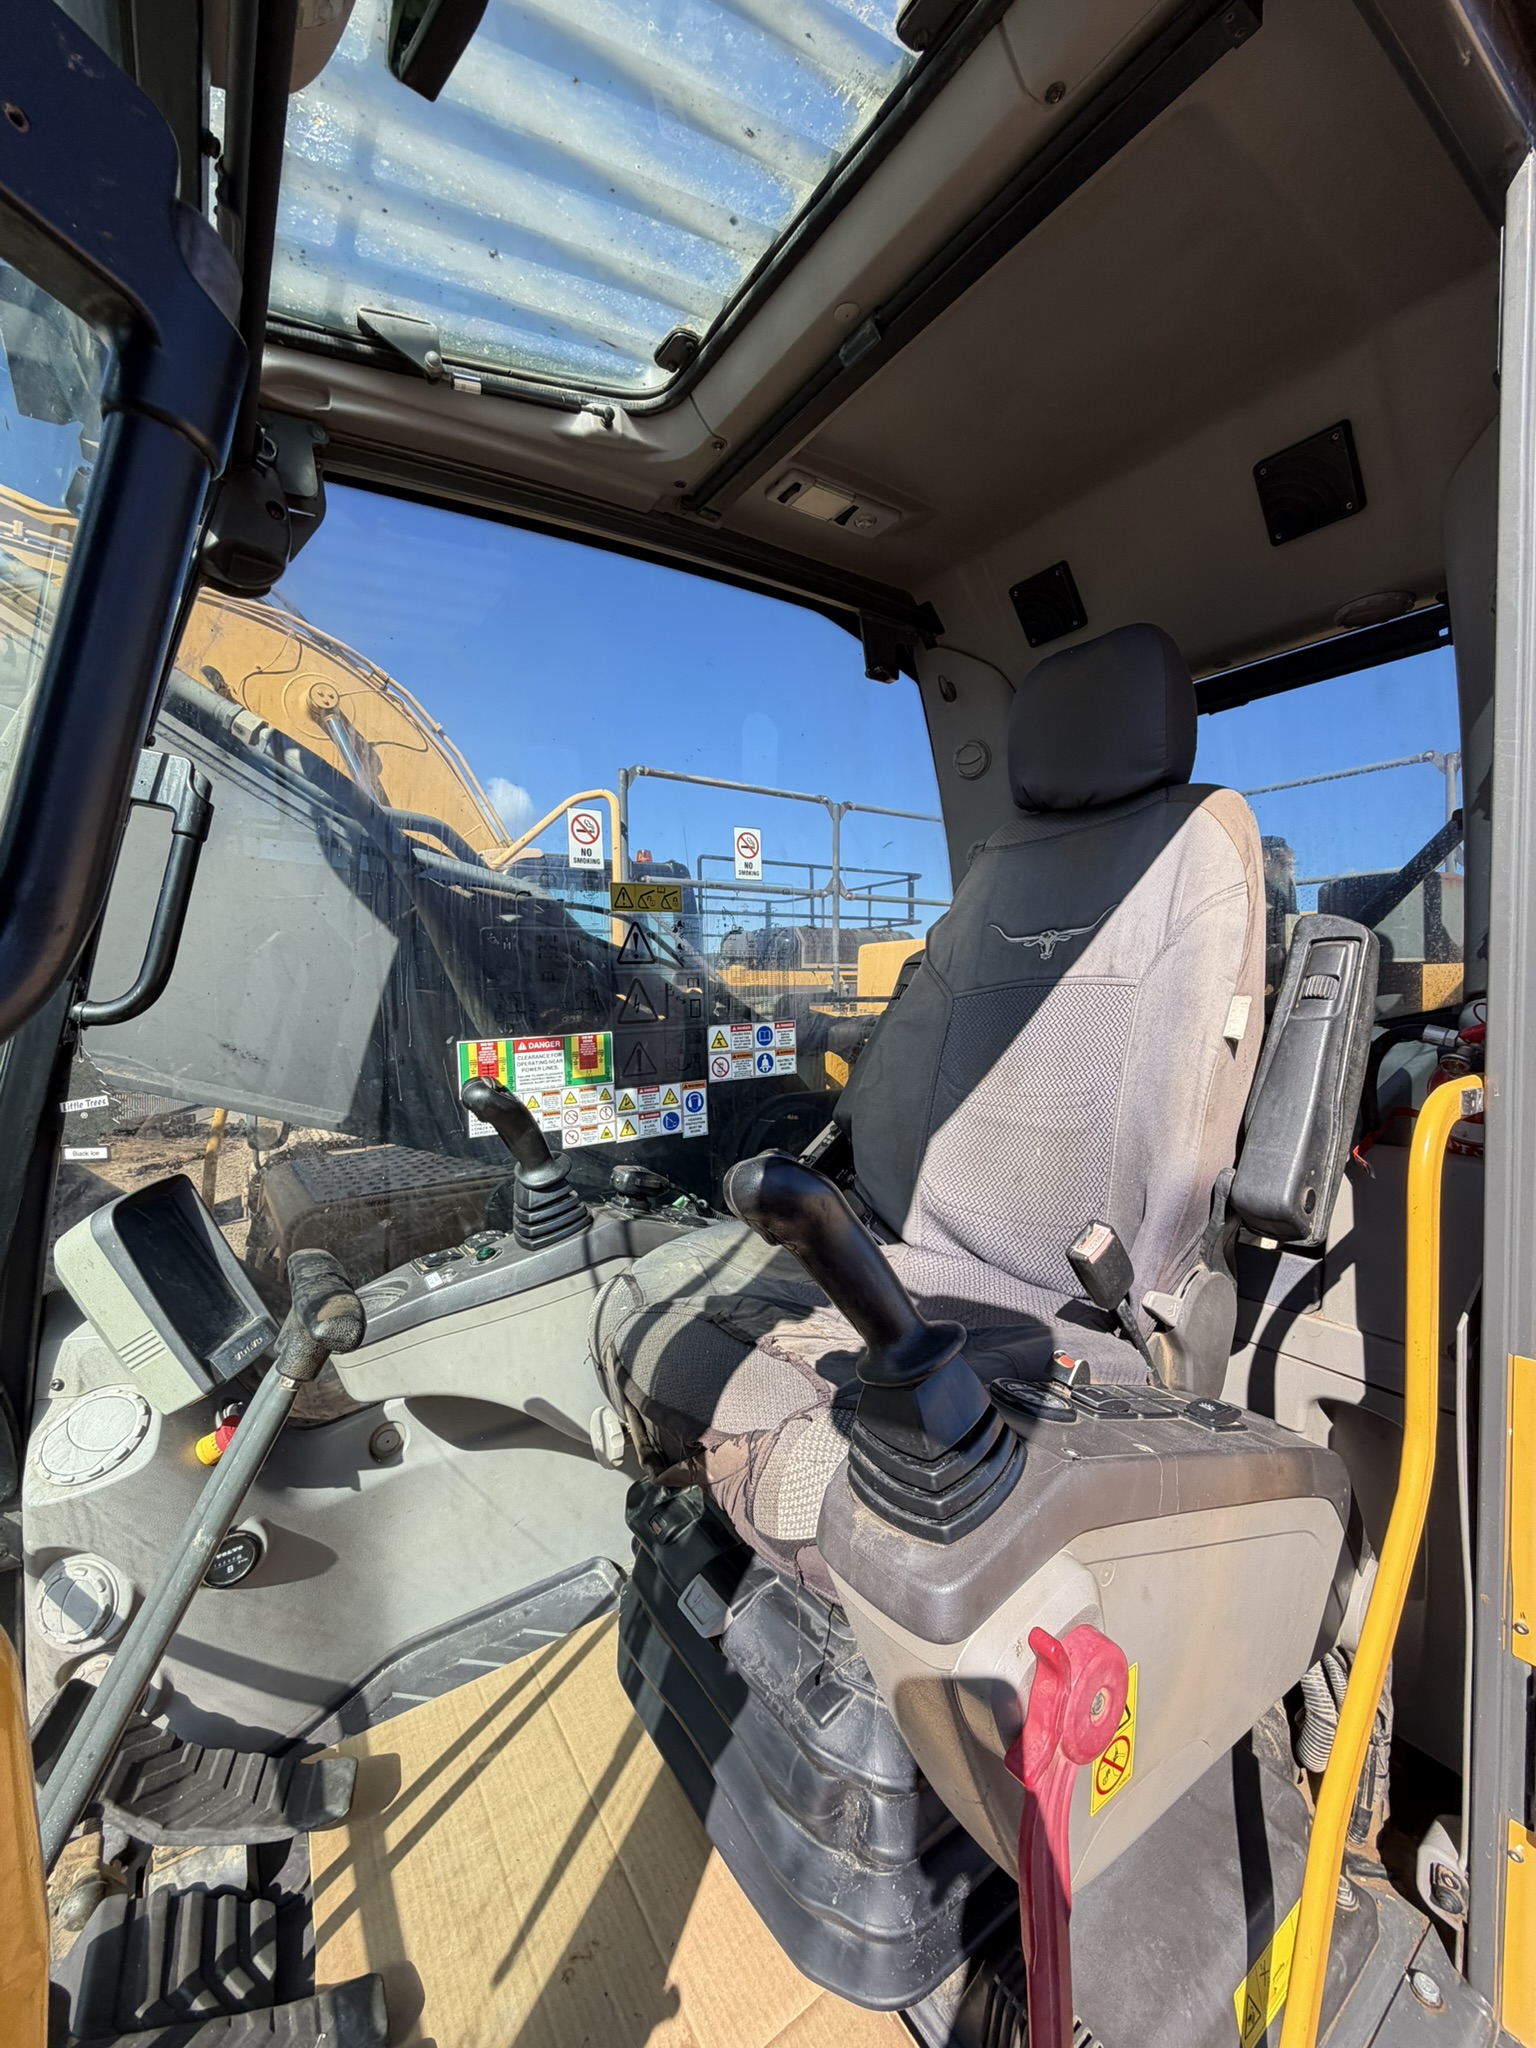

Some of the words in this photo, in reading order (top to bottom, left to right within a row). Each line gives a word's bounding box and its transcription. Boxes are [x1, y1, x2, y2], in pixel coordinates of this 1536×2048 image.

[581, 847, 593, 857] NO
[573, 857, 601, 865] SMOKING
[744, 861, 754, 870] NO
[528, 1040, 561, 1049] DANGER
[517, 1053, 550, 1061] CLEARANCE
[63, 1101, 83, 1111] Little
[85, 1098, 106, 1107] Trees
[234, 1337, 263, 1361] VOLVO
[216, 1545, 244, 1559] VOLVO
